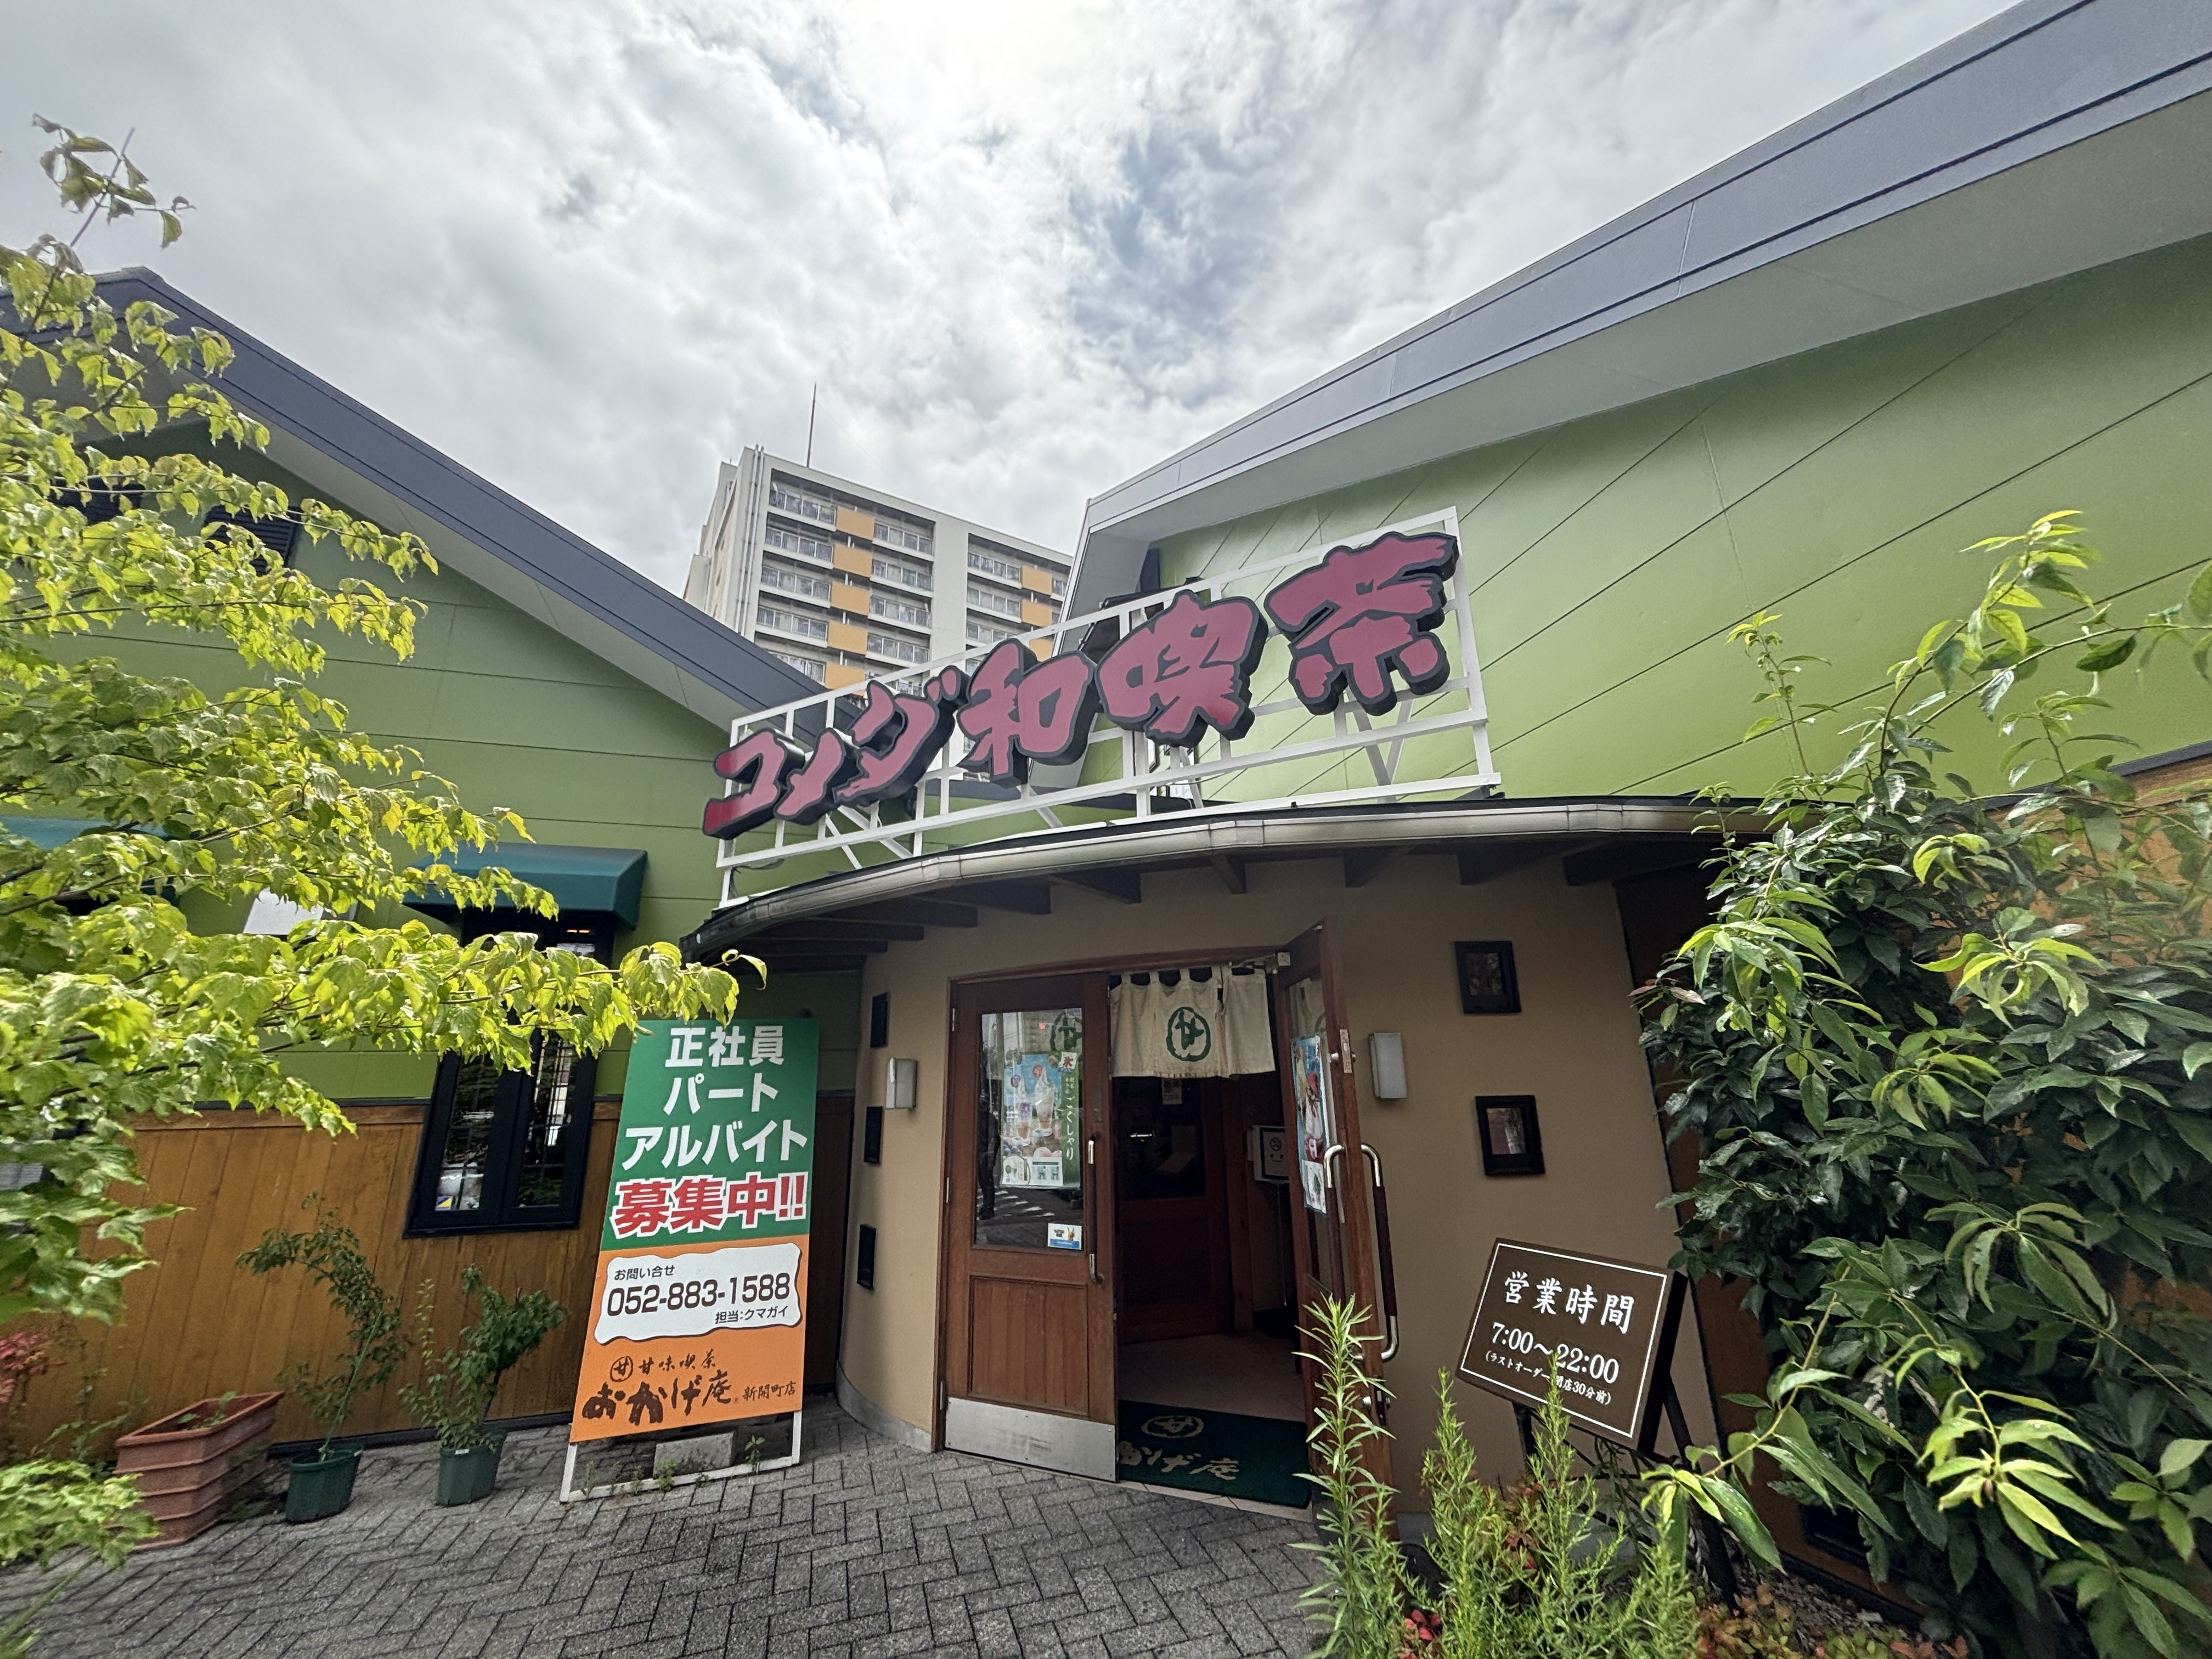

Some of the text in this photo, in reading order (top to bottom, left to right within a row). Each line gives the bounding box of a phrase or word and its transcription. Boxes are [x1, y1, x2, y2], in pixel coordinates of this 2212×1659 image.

[664, 1025, 785, 1068] 正社員
[663, 1073, 779, 1115] パート
[621, 1119, 808, 1171] アルバイト
[610, 1171, 809, 1239] 募集中!!
[607, 1272, 791, 1317] 052-883-1588
[614, 1265, 675, 1281] お問い合せ
[1504, 1270, 1635, 1335] 営業時間
[638, 1348, 716, 1375] 甘味喫茶
[582, 1369, 732, 1426] おかげ庵
